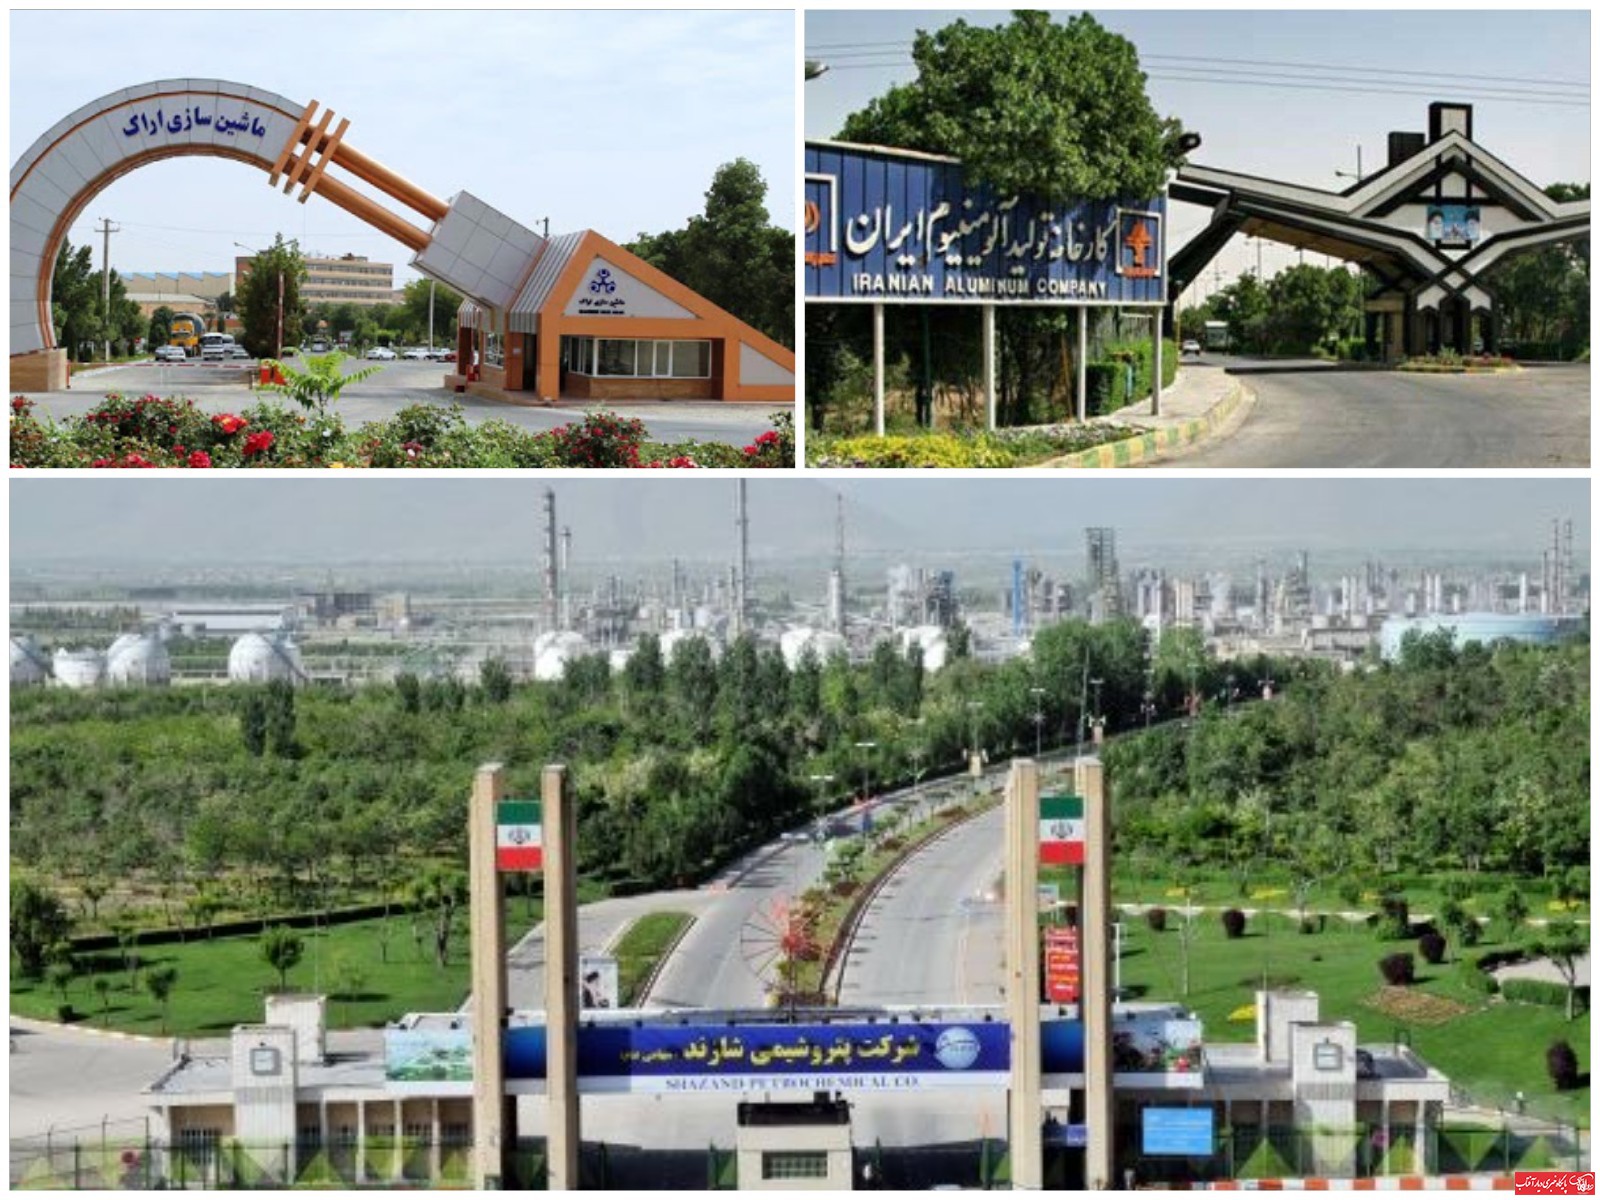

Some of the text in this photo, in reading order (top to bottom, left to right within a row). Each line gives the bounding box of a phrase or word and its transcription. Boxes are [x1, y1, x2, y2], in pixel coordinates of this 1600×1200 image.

[122, 105, 266, 138] ماشین سازی اراک
[845, 195, 1118, 275] کارخانه تولید آلومینیوم ایران
[851, 272, 1107, 299] IRANIAN ALUMINUM COMPANY
[682, 1036, 744, 1066] شازند
[750, 1036, 853, 1067] پتروشیمی
[857, 1034, 919, 1064] شرکت
[665, 1077, 744, 1091] SHAZAND
